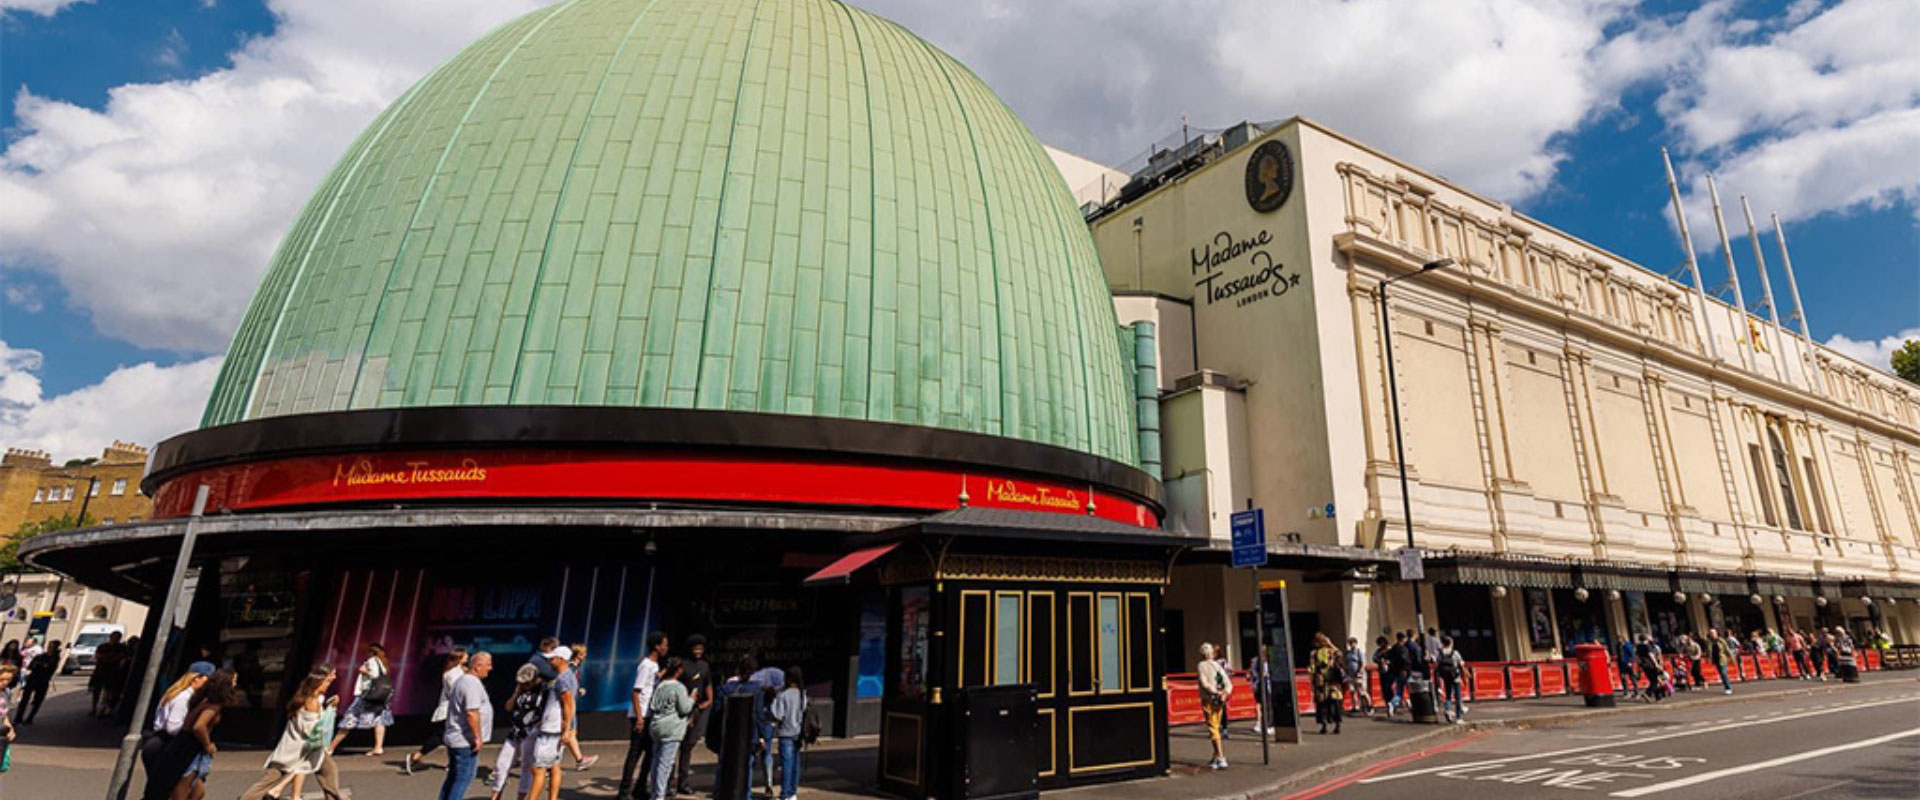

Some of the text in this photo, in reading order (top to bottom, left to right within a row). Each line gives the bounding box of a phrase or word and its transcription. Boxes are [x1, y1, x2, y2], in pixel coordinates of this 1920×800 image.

[1191, 230, 1273, 276] Madame
[1194, 250, 1289, 305] Tussauds
[1236, 290, 1268, 308] LONDON
[333, 458, 488, 486] Madame Tussauds
[987, 480, 1080, 509] Madame Tussauds
[482, 584, 541, 619] LIPA
[1549, 753, 1708, 769] BUS
[1436, 764, 1655, 790] LANE
